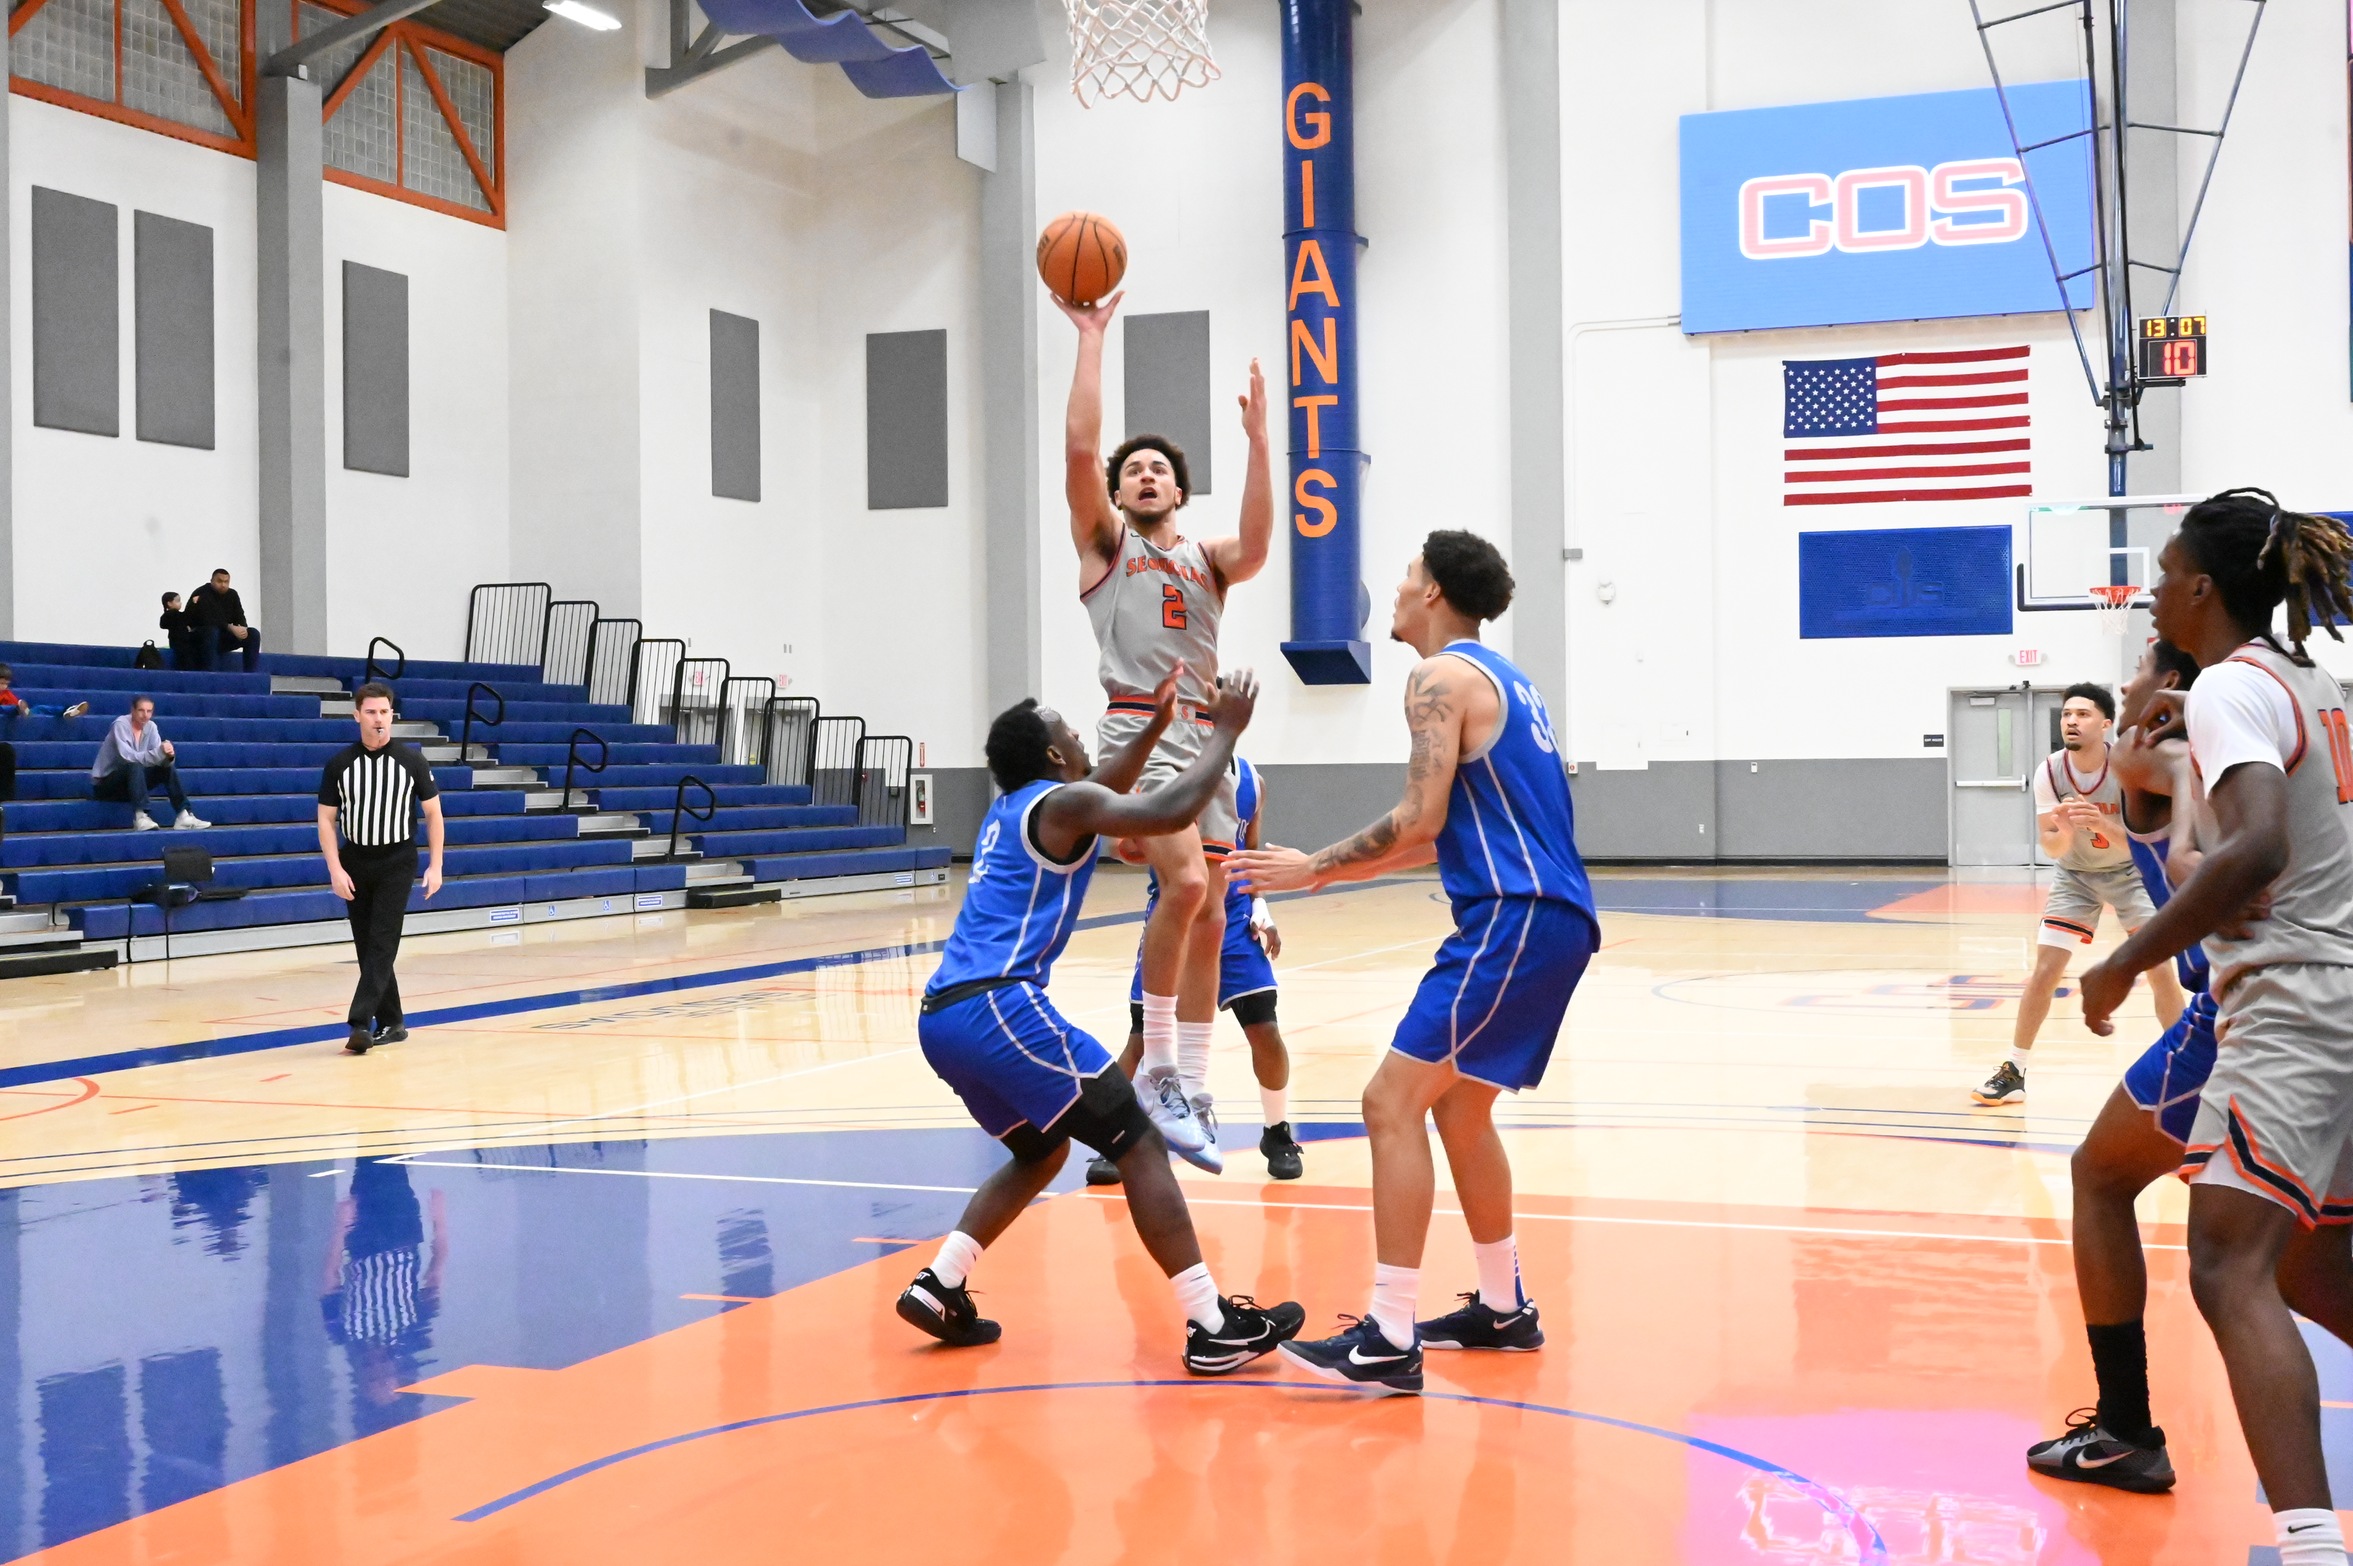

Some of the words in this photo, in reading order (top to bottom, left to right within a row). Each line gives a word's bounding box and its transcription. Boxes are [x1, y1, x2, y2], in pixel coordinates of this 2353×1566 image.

[1739, 157, 2028, 260] COS
[1286, 82, 1340, 538] GIANTS
[2146, 317, 2206, 338] 13:07
[2163, 341, 2195, 376] 10
[1162, 583, 1187, 630] 2
[2019, 649, 2037, 664] EXIT
[1181, 705, 1189, 720] S
